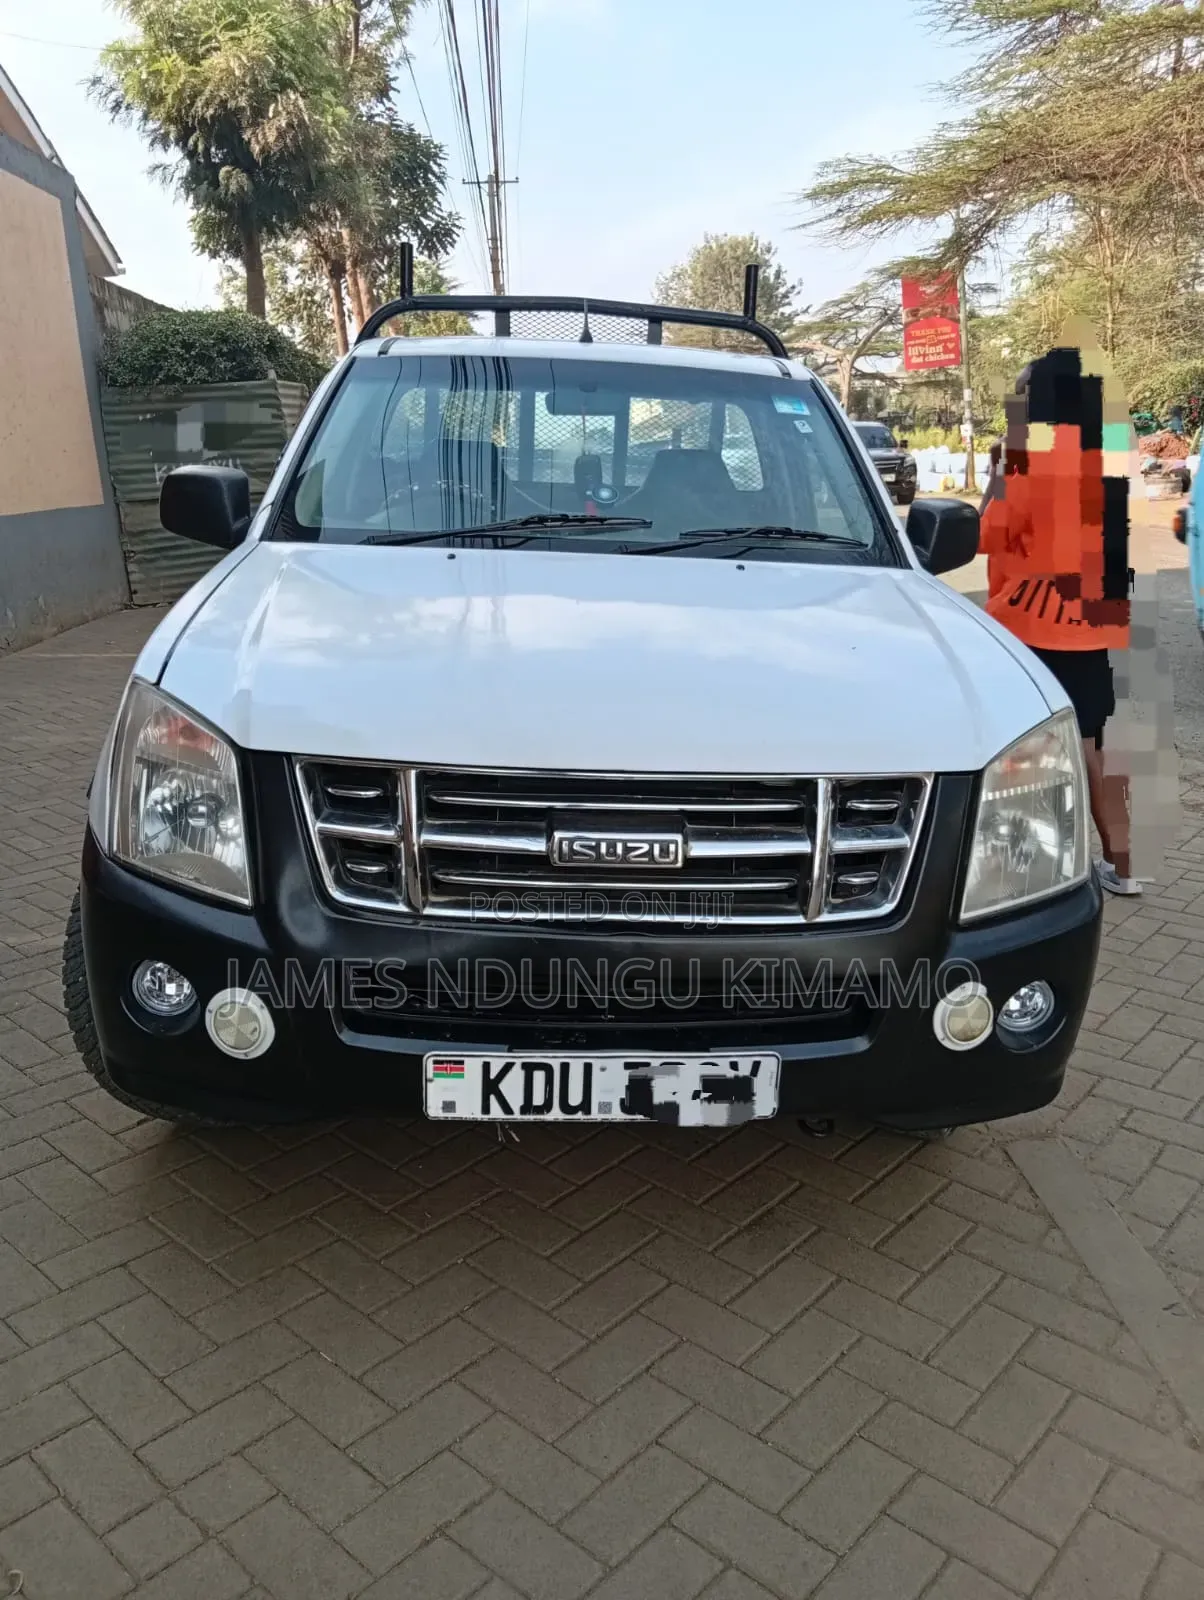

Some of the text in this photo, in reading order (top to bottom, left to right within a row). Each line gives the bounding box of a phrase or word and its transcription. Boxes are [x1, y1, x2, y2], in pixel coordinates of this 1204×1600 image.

[925, 353, 956, 362] chicken
[561, 839, 677, 864] ISUZU
[480, 1060, 593, 1116] KDU
